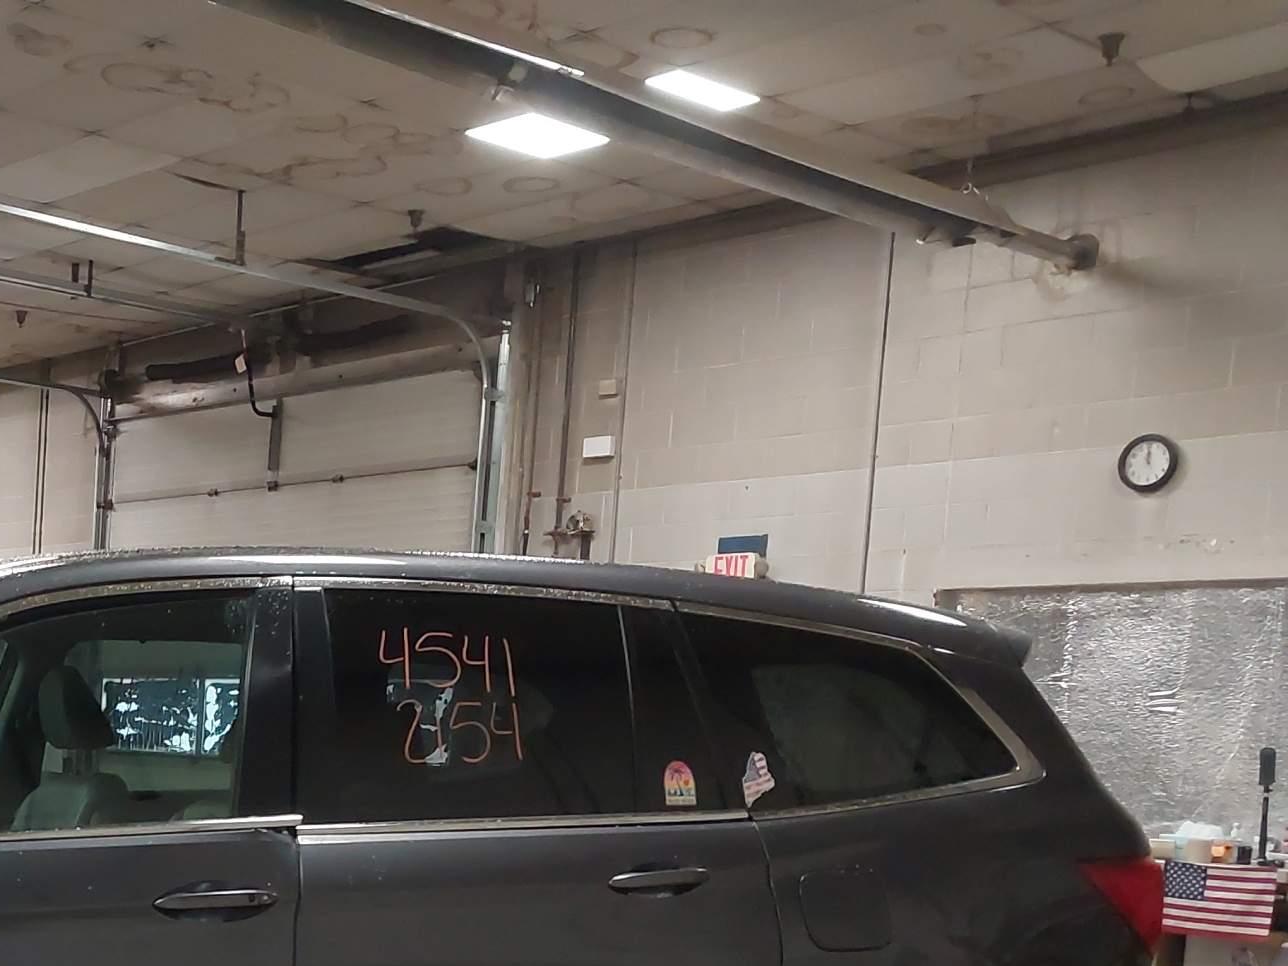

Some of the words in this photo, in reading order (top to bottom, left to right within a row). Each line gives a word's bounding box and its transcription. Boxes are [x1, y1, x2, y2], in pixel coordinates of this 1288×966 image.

[714, 554, 749, 577] EXIT
[379, 626, 516, 697] 4541
[396, 699, 523, 764] 2154
